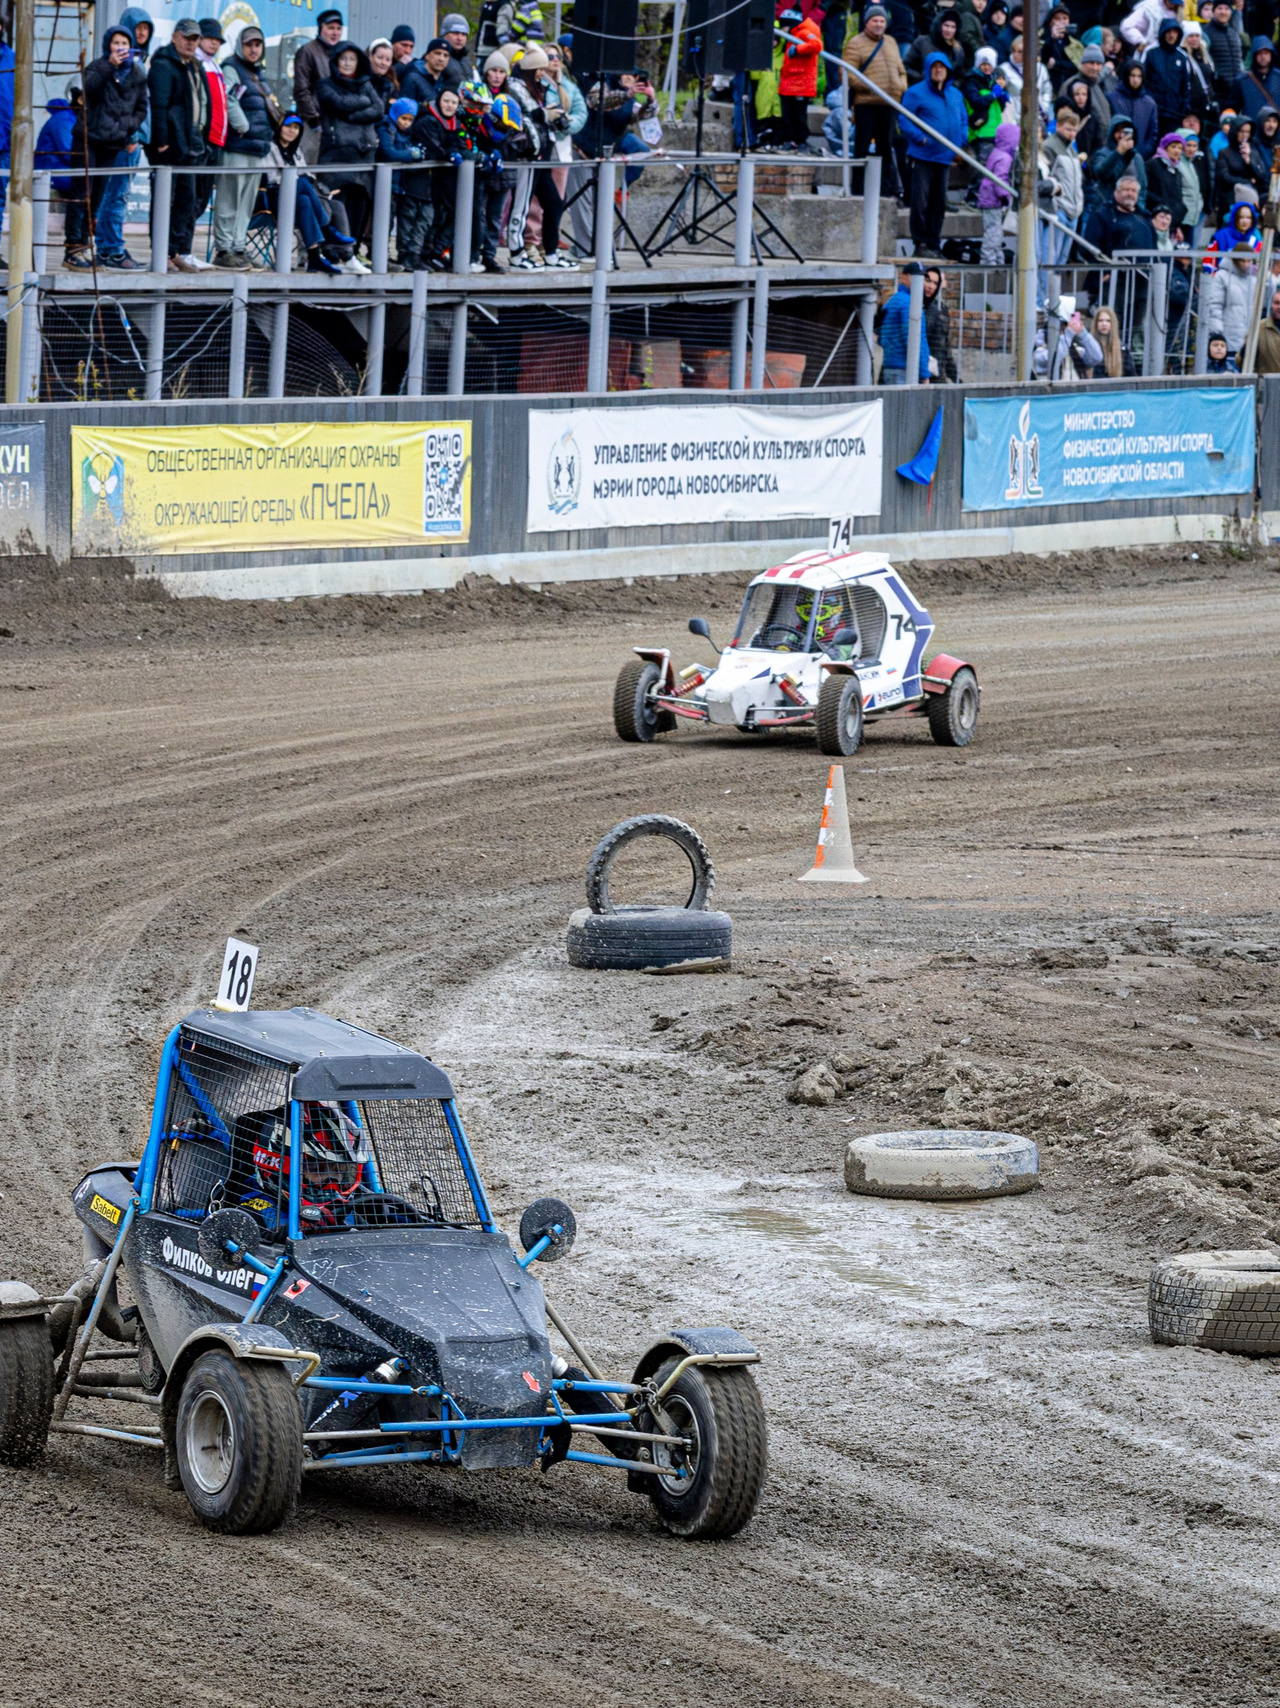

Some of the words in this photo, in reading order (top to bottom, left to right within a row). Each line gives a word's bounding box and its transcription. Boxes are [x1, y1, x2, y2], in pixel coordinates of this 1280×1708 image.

[1064, 409, 1135, 431] МИНИСТЕРСТВО
[594, 443, 667, 465] УПРАВЛЕНИЕ
[671, 435, 750, 461] ФИЗИЧЕСКОЙ
[753, 440, 812, 460] КУЛЬТУРЫ
[814, 439, 823, 458] И
[824, 437, 866, 457] СПОРТА
[1063, 433, 1124, 459] ФИЗИЧЕСКОЙ
[1125, 435, 1171, 455] КУЛЬТУРЫ
[1172, 434, 1180, 452] И
[1180, 433, 1214, 452] СПОРТА
[147, 447, 253, 478] ОБЩЕСТВЕННАЯ
[256, 445, 347, 474] ОРГАНИЗАЦИЯ
[349, 445, 401, 468] ОХРАНЫ
[1063, 459, 1142, 486] НОВОСИБИРСКОЙ
[1144, 461, 1184, 481] ОБЛАСТИ
[593, 478, 633, 499] МЭРИИ
[636, 476, 683, 500] ГОРОДА
[686, 473, 779, 495] НОВОСИБИРСКА
[154, 495, 248, 529] ОКРУЖАЮЩЕЙ
[251, 498, 296, 526] СРЕДЫ
[300, 482, 390, 520] «ПЧЕЛА»
[831, 517, 851, 549] 74
[890, 613, 917, 641] 74
[226, 950, 252, 1006] 18
[93, 1197, 117, 1222] Sabelt
[162, 1236, 213, 1277] Филков
